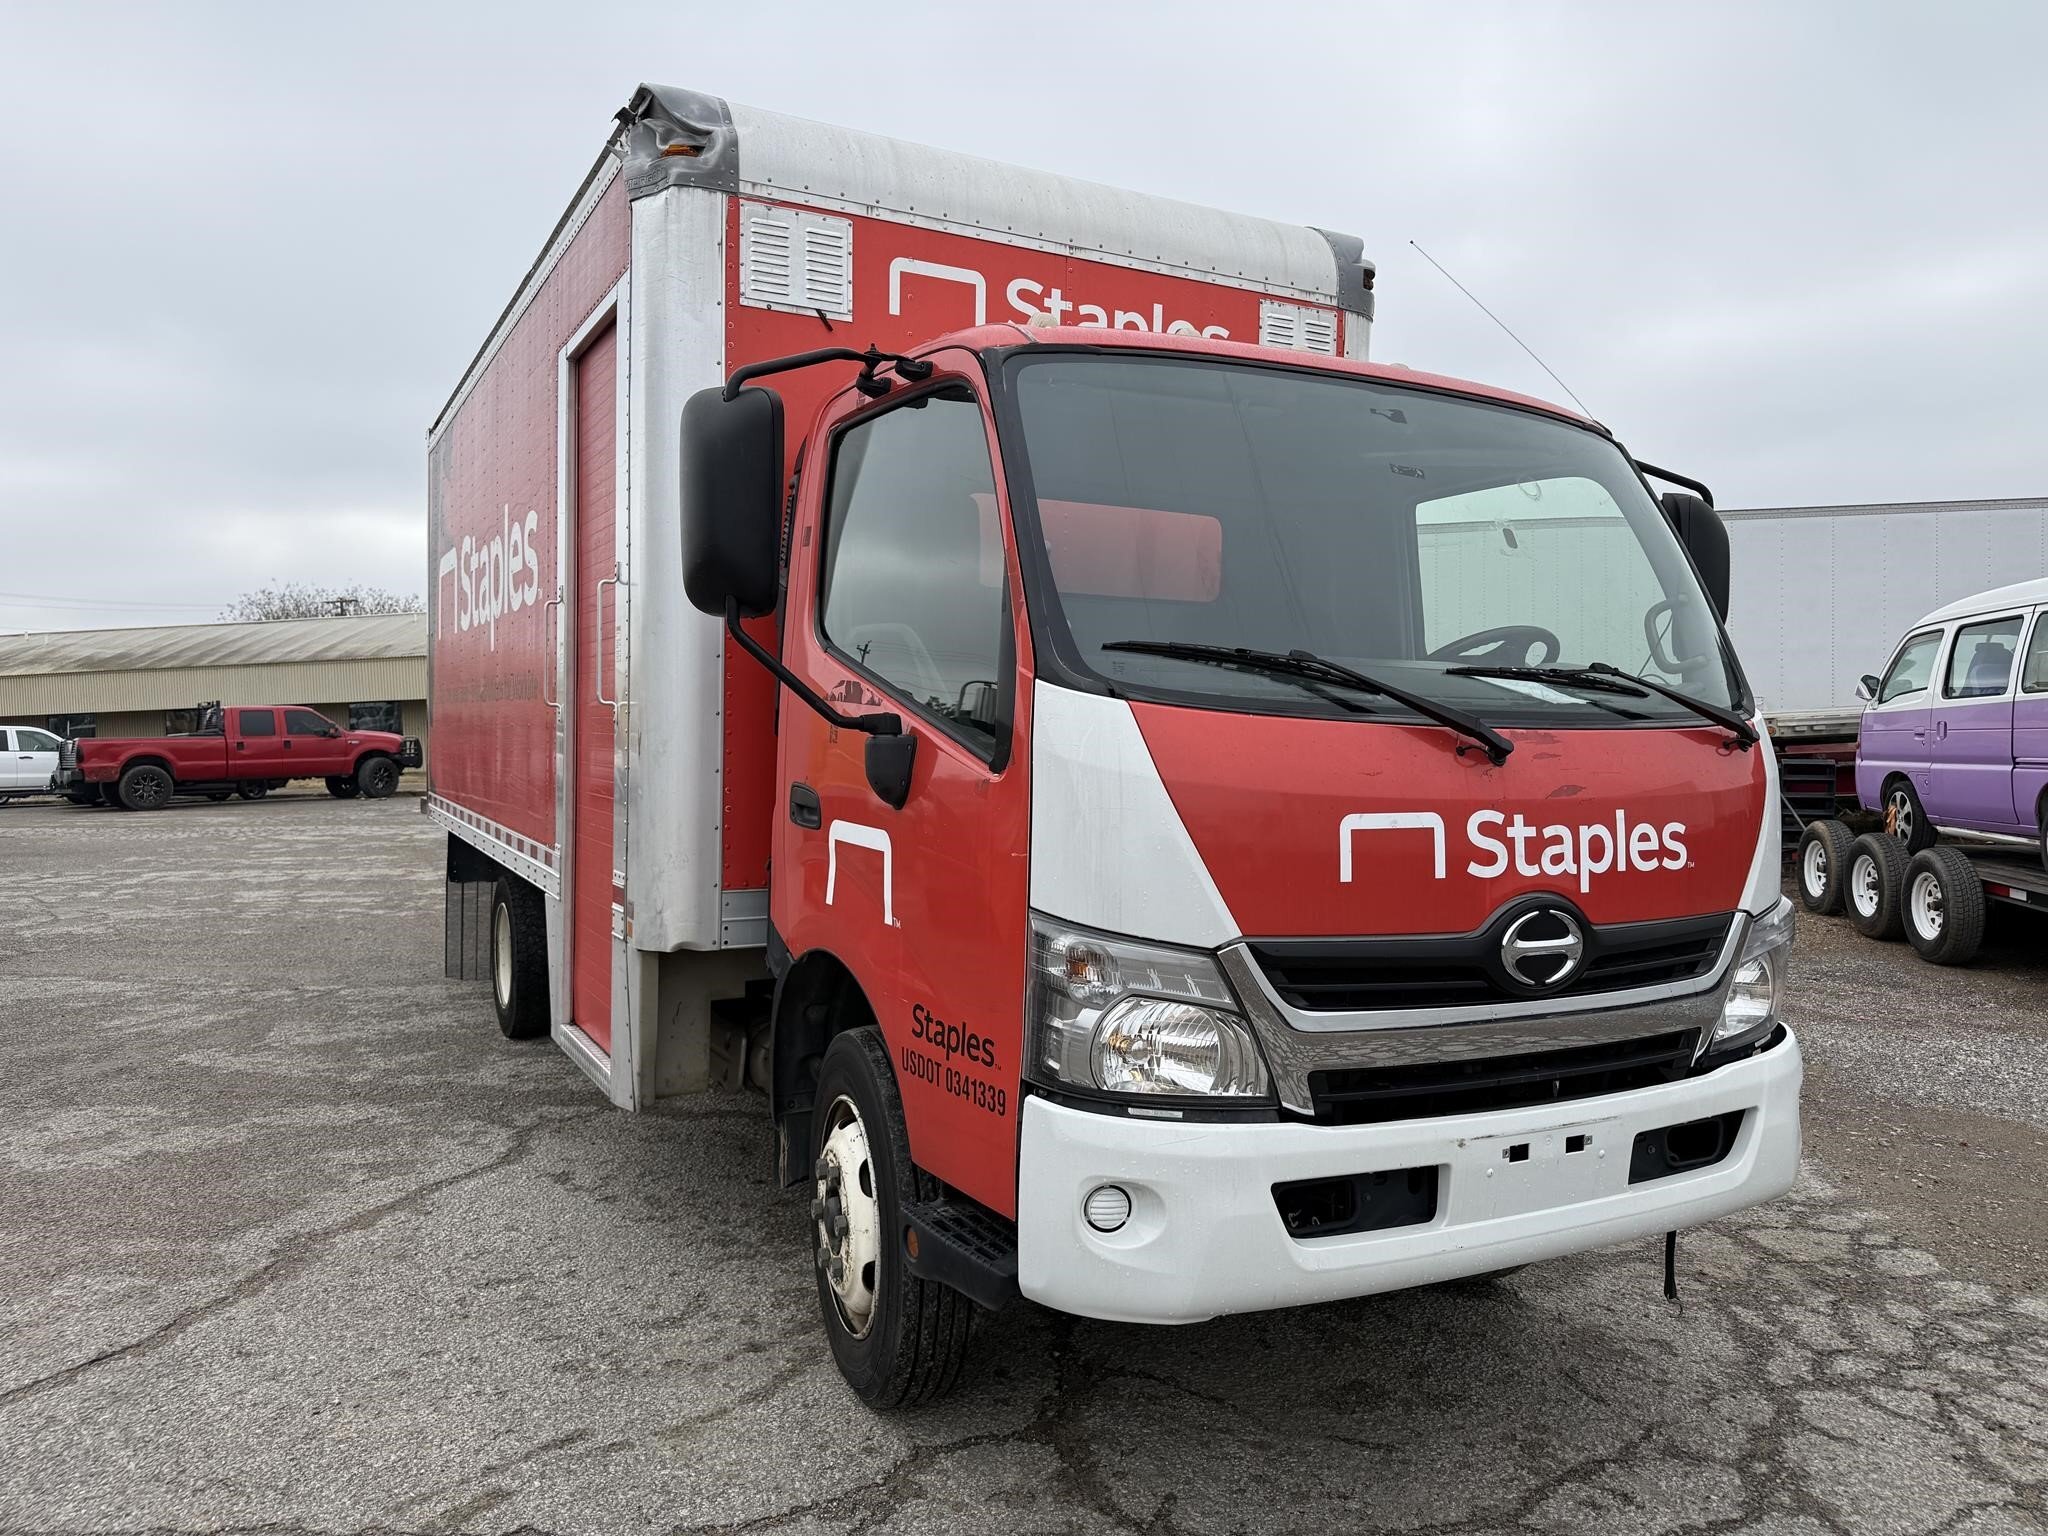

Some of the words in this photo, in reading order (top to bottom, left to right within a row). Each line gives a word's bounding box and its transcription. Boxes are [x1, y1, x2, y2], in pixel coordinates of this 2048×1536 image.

[460, 503, 539, 652] Staples
[1466, 809, 1688, 893] Staples
[911, 1003, 995, 1068] Staples
[901, 1046, 942, 1088] USDOT
[945, 1066, 1006, 1117] 0341339
